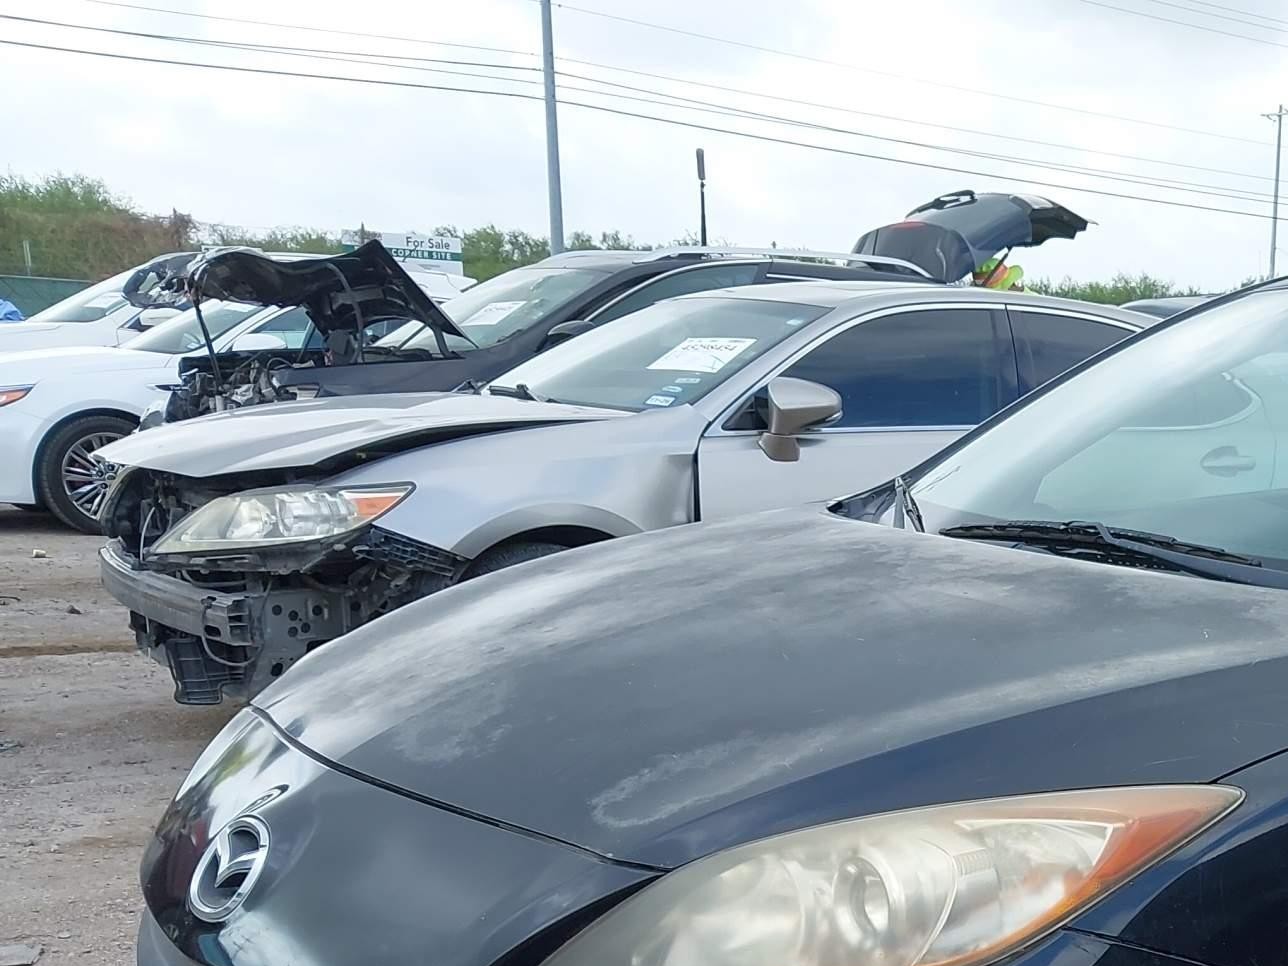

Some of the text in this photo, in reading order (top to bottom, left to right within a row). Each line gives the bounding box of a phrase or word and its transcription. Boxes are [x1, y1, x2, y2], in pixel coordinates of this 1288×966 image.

[405, 236, 451, 250] For Sale
[432, 251, 452, 260] SITE
